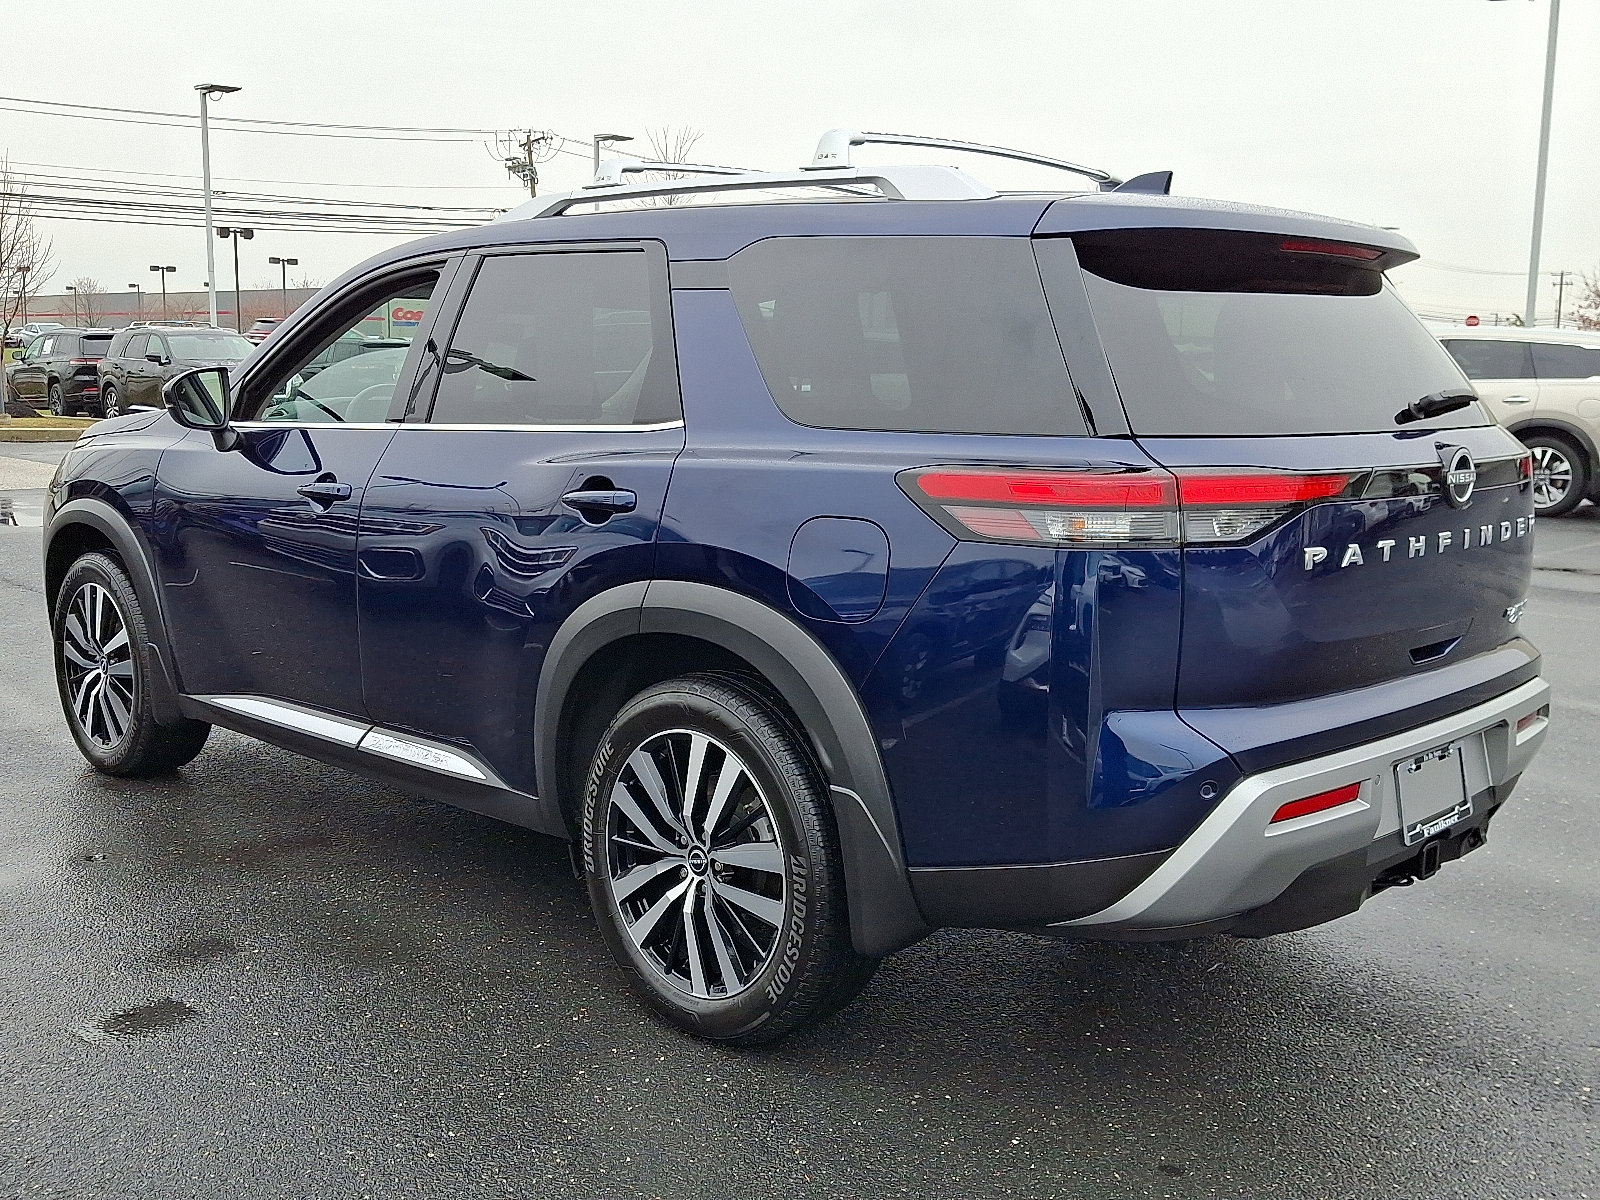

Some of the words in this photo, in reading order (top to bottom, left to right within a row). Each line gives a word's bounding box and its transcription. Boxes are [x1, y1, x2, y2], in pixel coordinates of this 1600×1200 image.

[583, 738, 615, 873] BRIDGESTONE
[1423, 814, 1459, 837] Faulkner
[765, 854, 808, 1005] BRIDGESTONE
